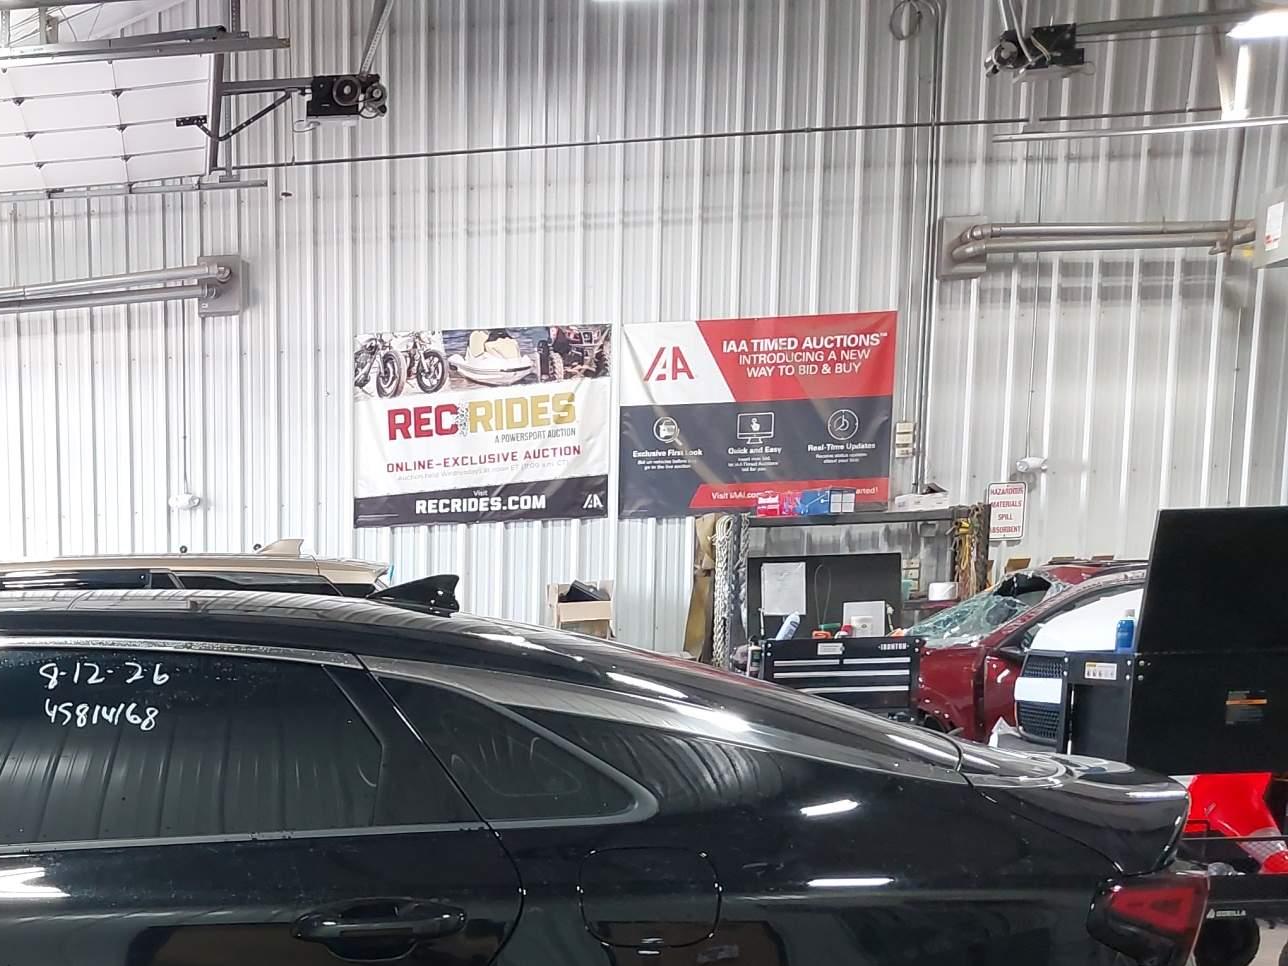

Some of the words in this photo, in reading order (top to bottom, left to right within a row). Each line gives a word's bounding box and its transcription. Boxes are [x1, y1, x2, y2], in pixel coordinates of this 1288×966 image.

[722, 340, 748, 354] IAA
[751, 336, 799, 352] TIMED
[739, 351, 824, 366] INTRODUCING
[828, 350, 839, 362] A
[840, 348, 872, 362] NEW
[746, 364, 775, 378] WAY
[778, 364, 795, 377] TO
[798, 363, 820, 375] BID
[822, 363, 831, 375] &
[834, 361, 862, 374] BUY
[387, 403, 460, 441] REC
[468, 391, 577, 434] RIDES
[494, 434, 500, 444] A
[501, 430, 546, 443] POWERSPORT
[547, 427, 576, 439] AUCTION
[386, 451, 518, 473] ONLINE-EXCLUSIVE
[523, 444, 581, 460] AUCTION
[764, 445, 782, 454] Easy
[473, 489, 488, 497] Visit
[415, 494, 546, 514] RECRIDES.COM
[998, 513, 1014, 521] SPILL
[45, 698, 159, 731] 45814168
